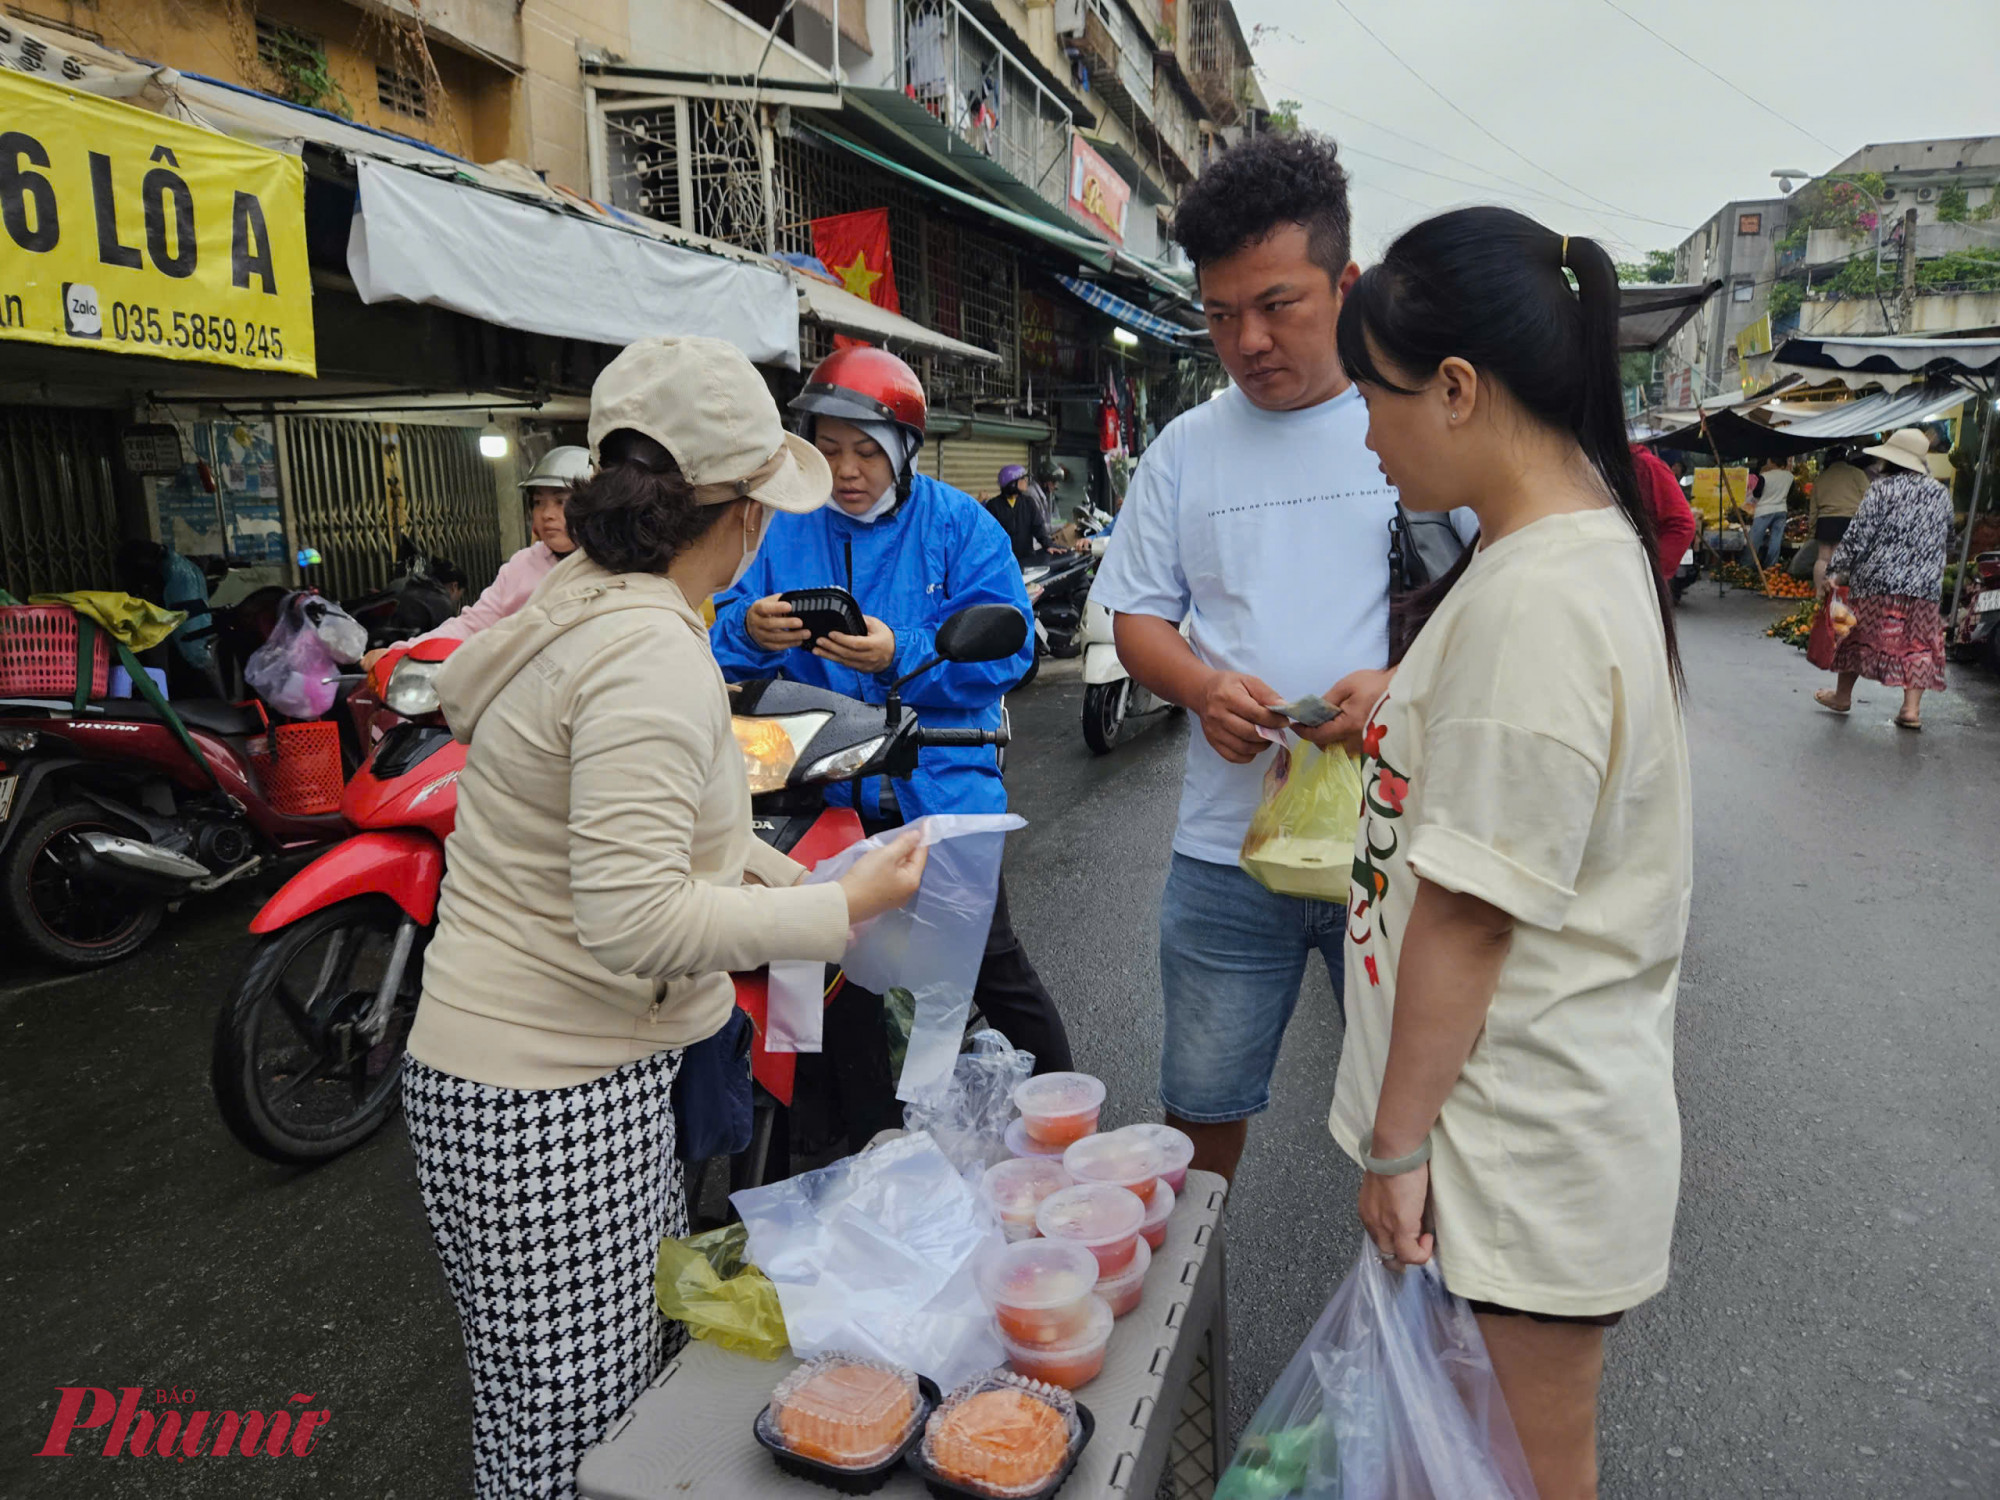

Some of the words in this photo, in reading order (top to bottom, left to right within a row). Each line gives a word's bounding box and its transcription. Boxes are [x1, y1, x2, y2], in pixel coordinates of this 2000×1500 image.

[88, 144, 198, 279] LÔ
[231, 190, 278, 296] A
[72, 298, 98, 316] Zalo
[112, 301, 284, 361] 035.5859.245
[1207, 509, 1226, 517] love
[1229, 505, 1246, 513] has
[1263, 498, 1303, 506] concept
[1360, 488, 1379, 496] bad
[67, 722, 140, 731] VISION
